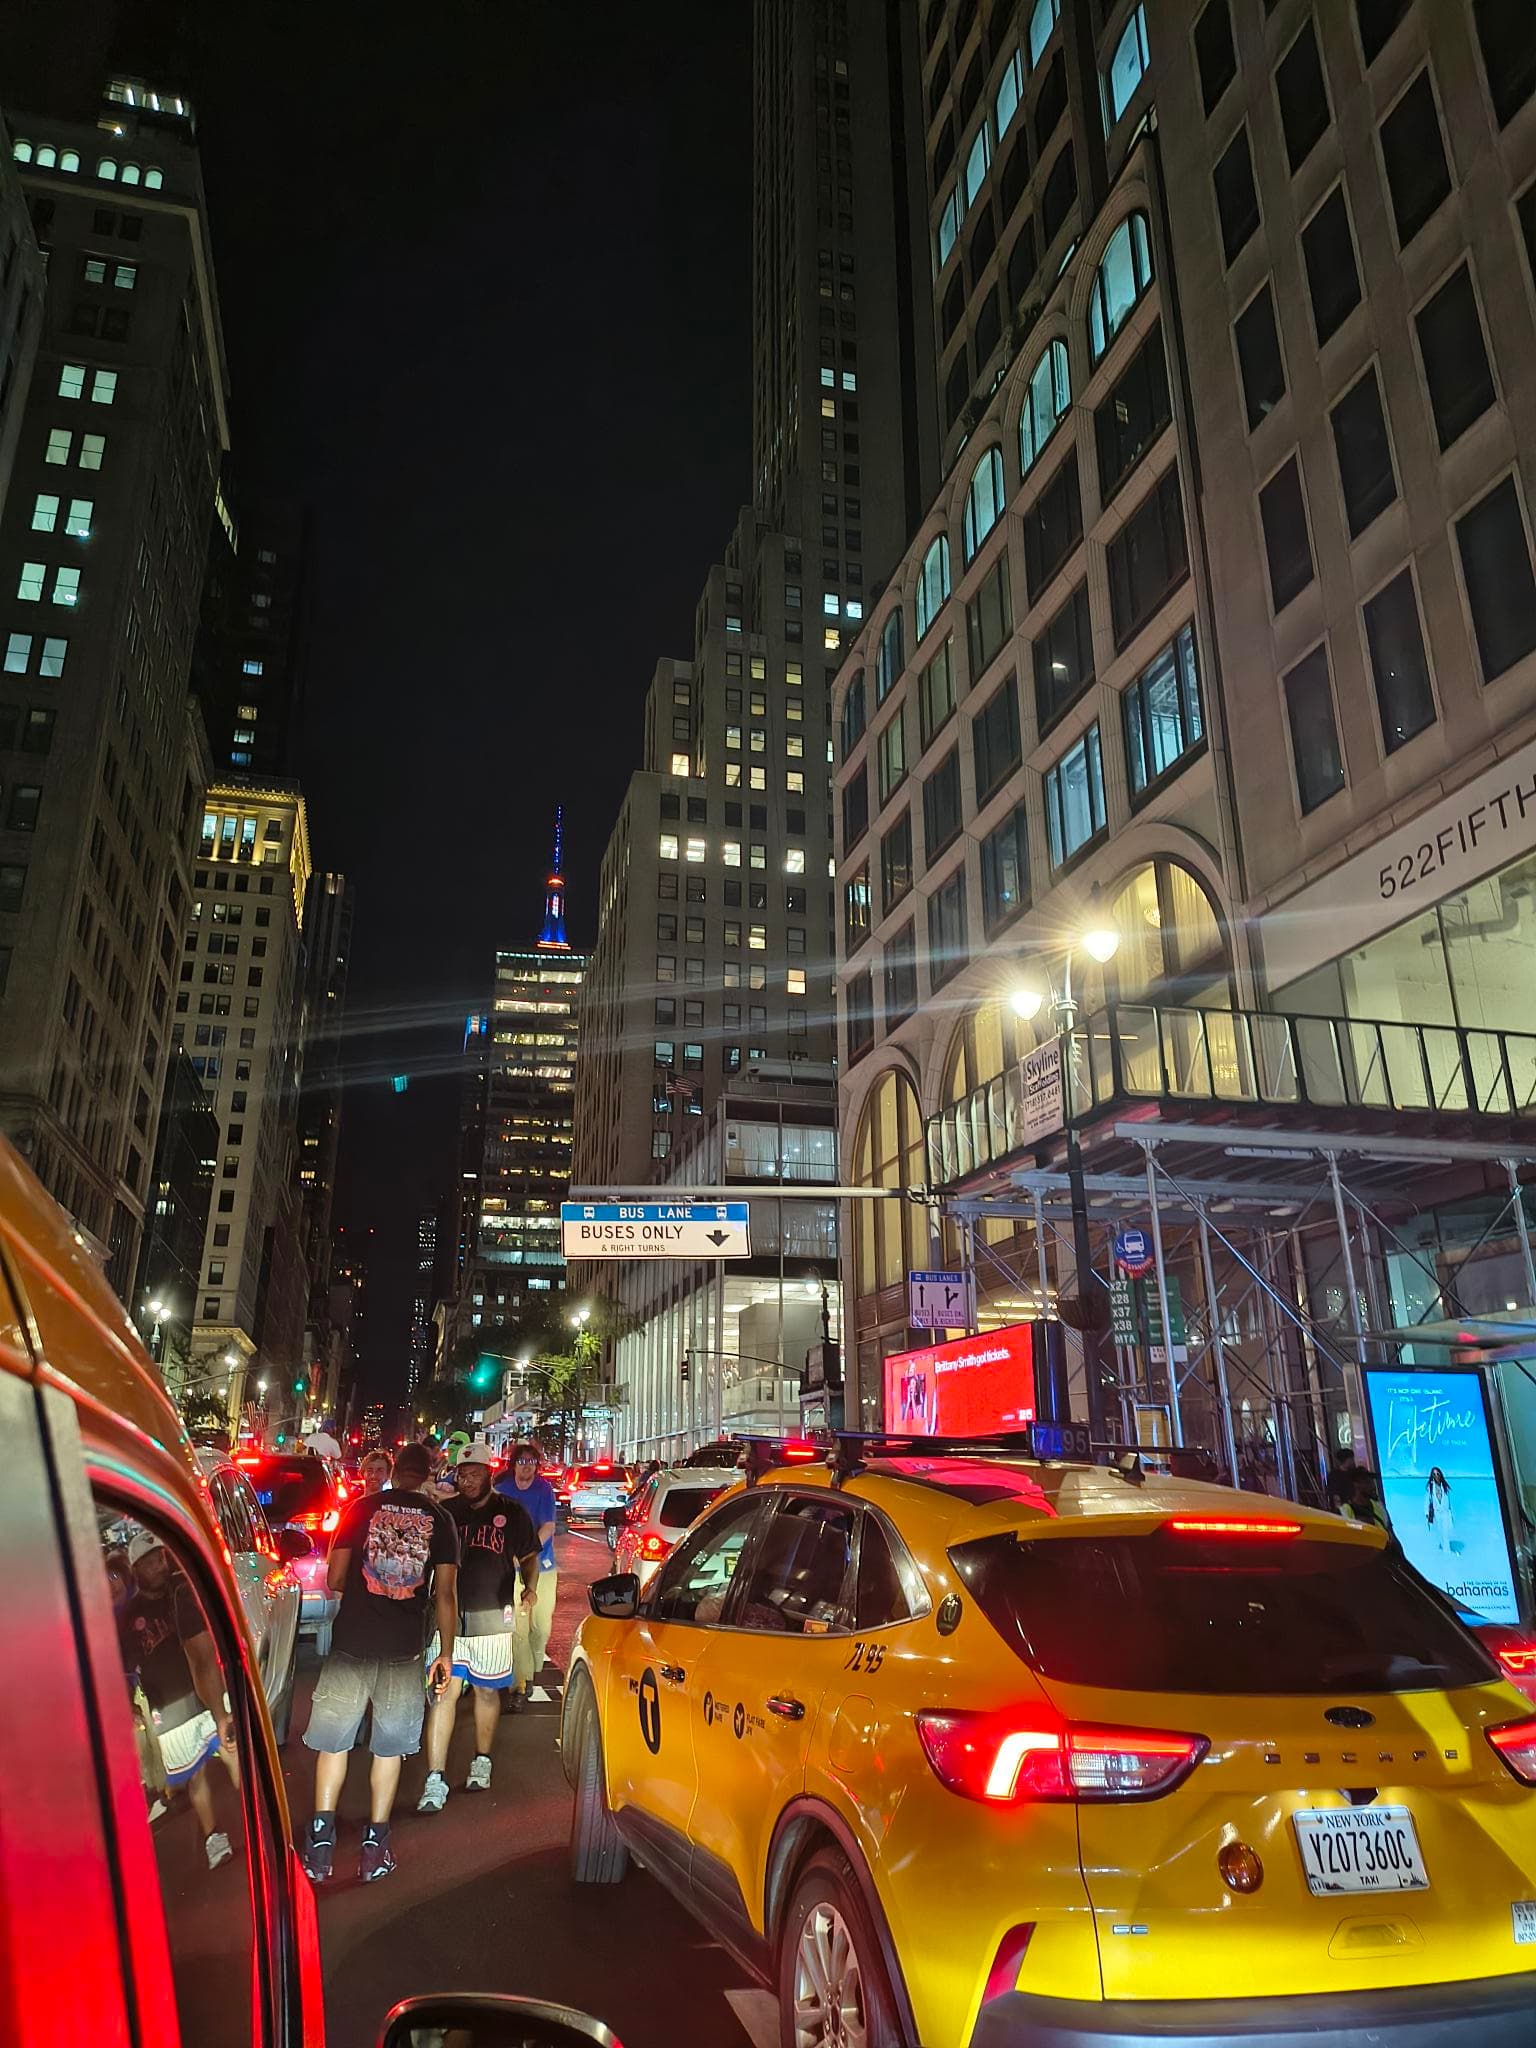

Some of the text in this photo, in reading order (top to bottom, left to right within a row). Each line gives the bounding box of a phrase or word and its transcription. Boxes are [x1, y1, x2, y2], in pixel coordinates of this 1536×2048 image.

[1026, 1049, 1059, 1081] Skyline
[619, 1207, 693, 1219] BUS LANE
[581, 1225, 684, 1239] BUSES ONLY
[601, 1244, 666, 1252] & RIGHT TURNS
[1114, 1333, 1136, 1344] MTA
[934, 1360, 958, 1374] Brittany
[958, 1353, 977, 1368] Smith
[976, 1352, 987, 1367] got
[1387, 1395, 1476, 1463] Lifetime
[381, 1504, 423, 1515] NEW YORK
[1446, 1581, 1509, 1597] bahamas
[1325, 1812, 1385, 1828] NEW YORK
[1309, 1829, 1413, 1874] Y207360C
[1360, 1875, 1379, 1885] TAXI
